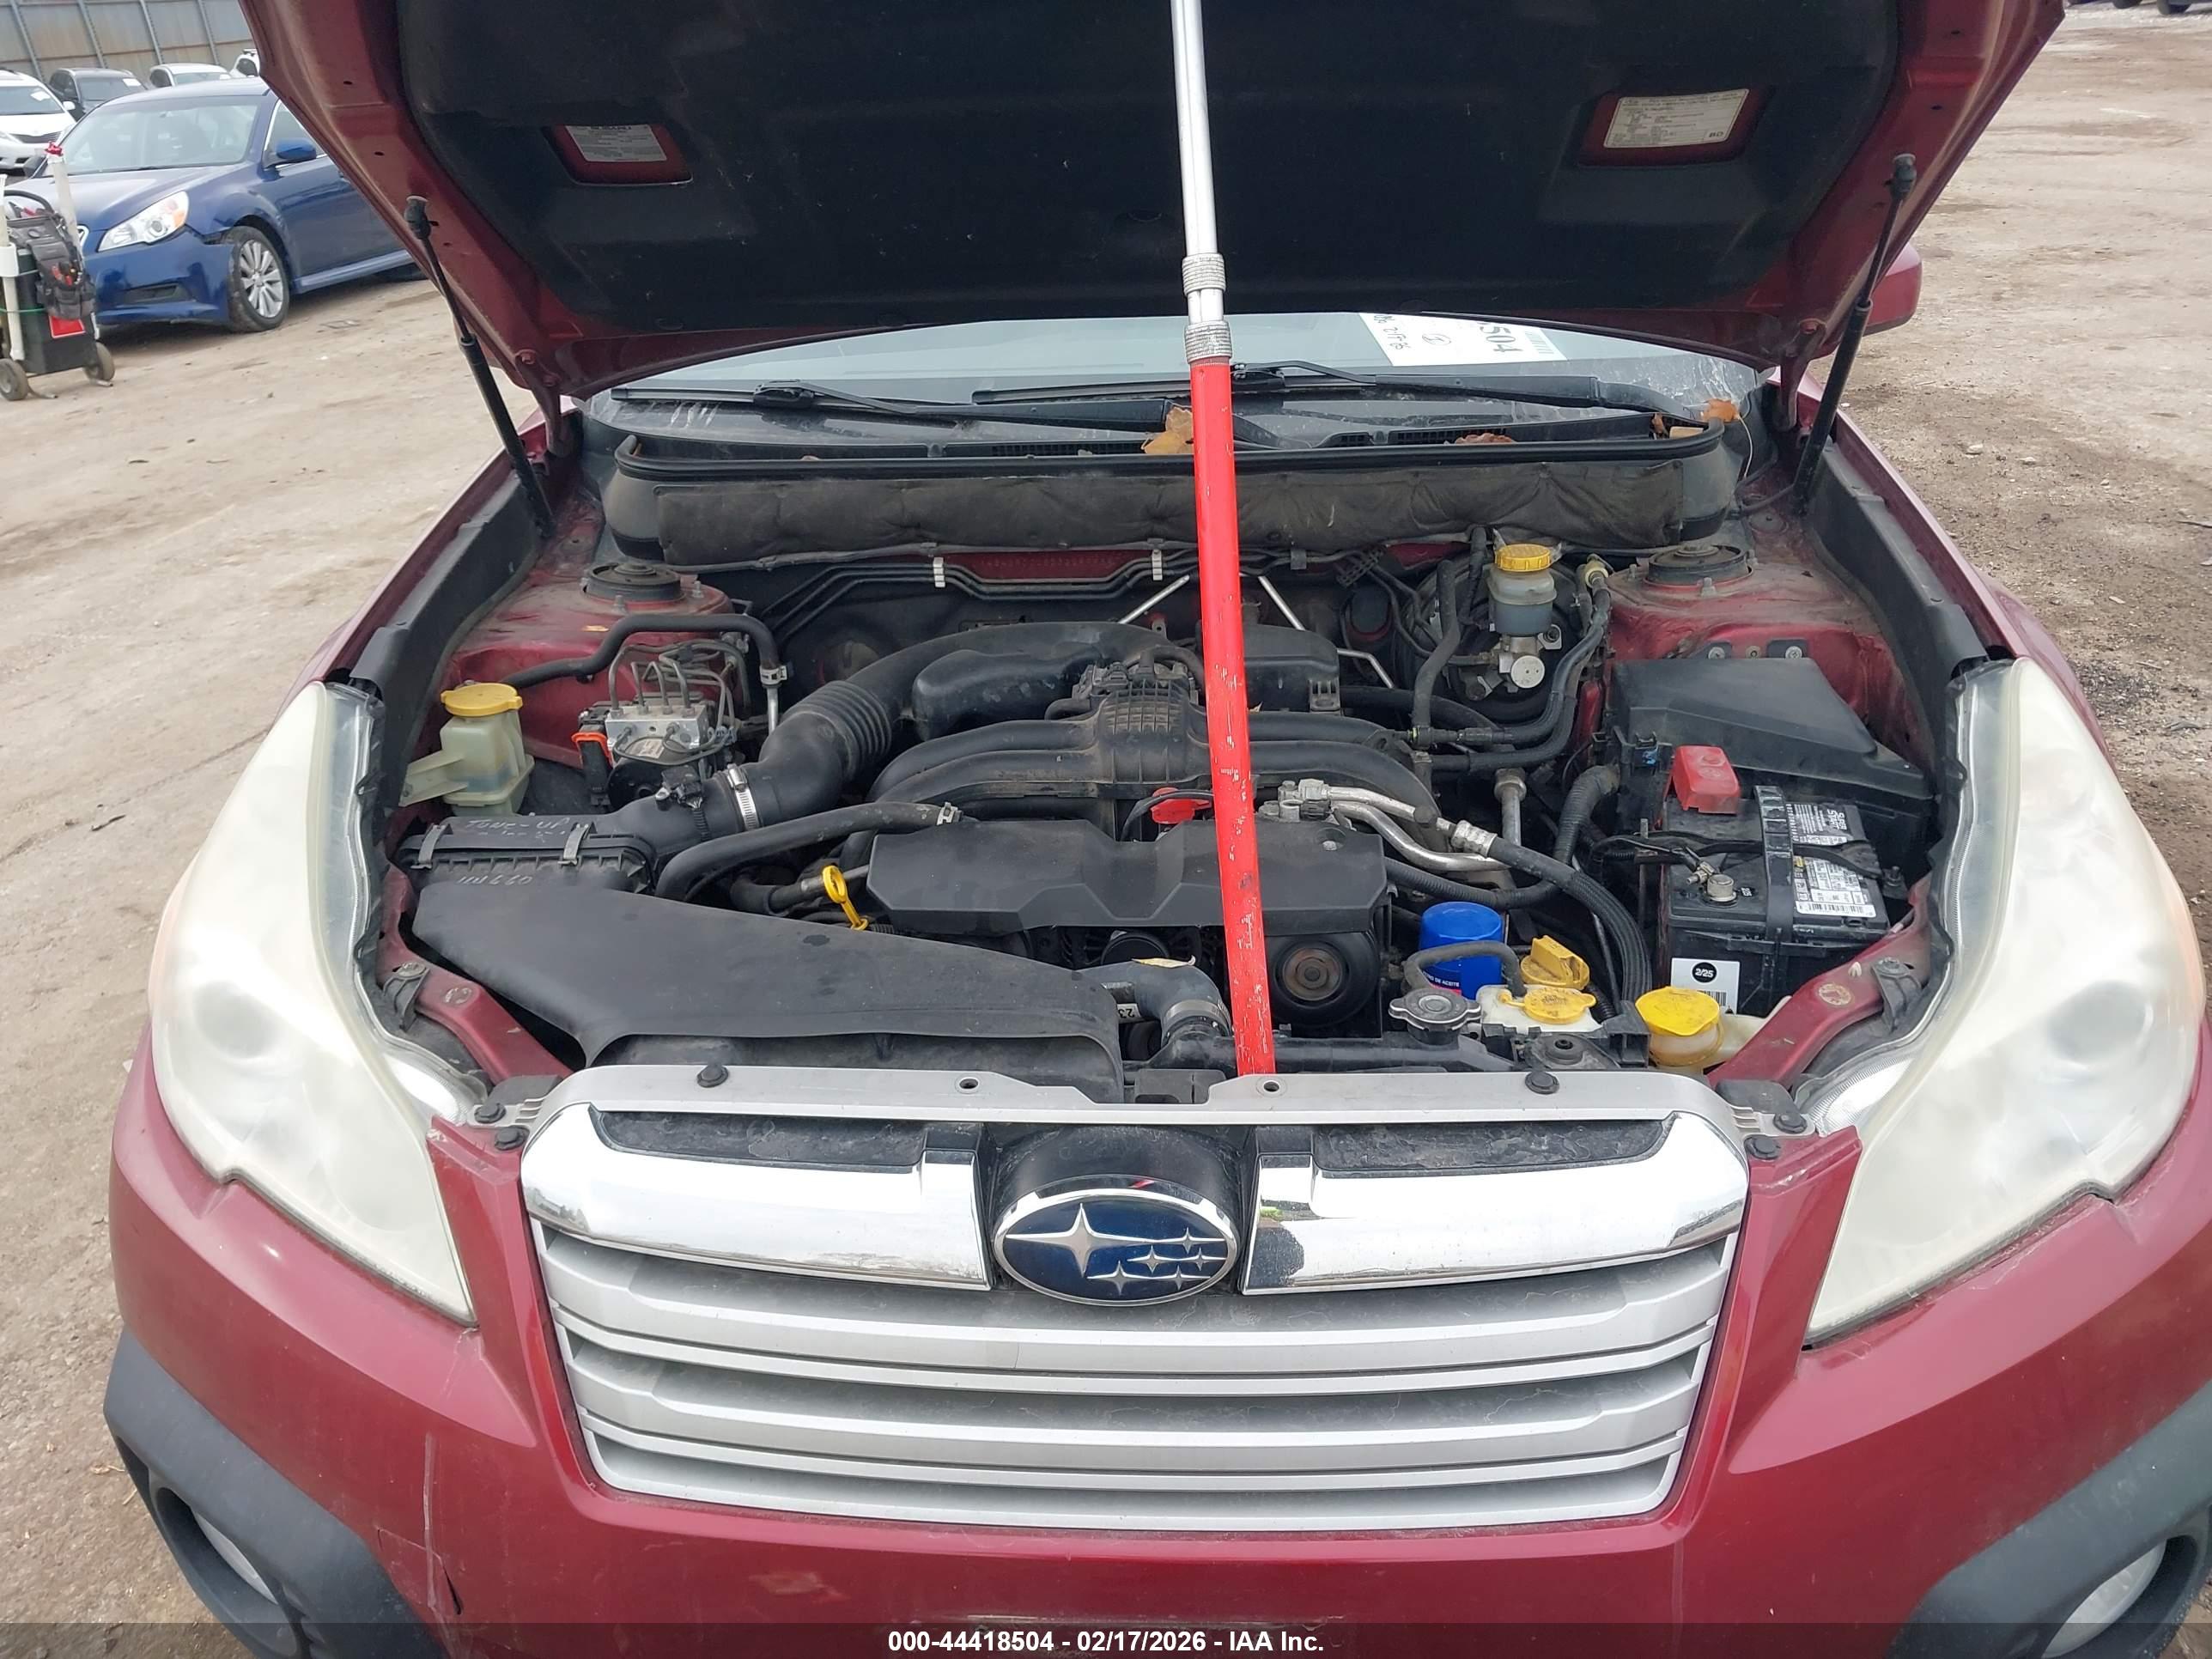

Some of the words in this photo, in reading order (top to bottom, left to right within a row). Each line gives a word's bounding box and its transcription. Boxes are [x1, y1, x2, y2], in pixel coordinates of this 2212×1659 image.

[1477, 322, 1523, 353] 504
[1695, 968, 1714, 978] 2/25
[1442, 979, 1460, 988] ACEITE
